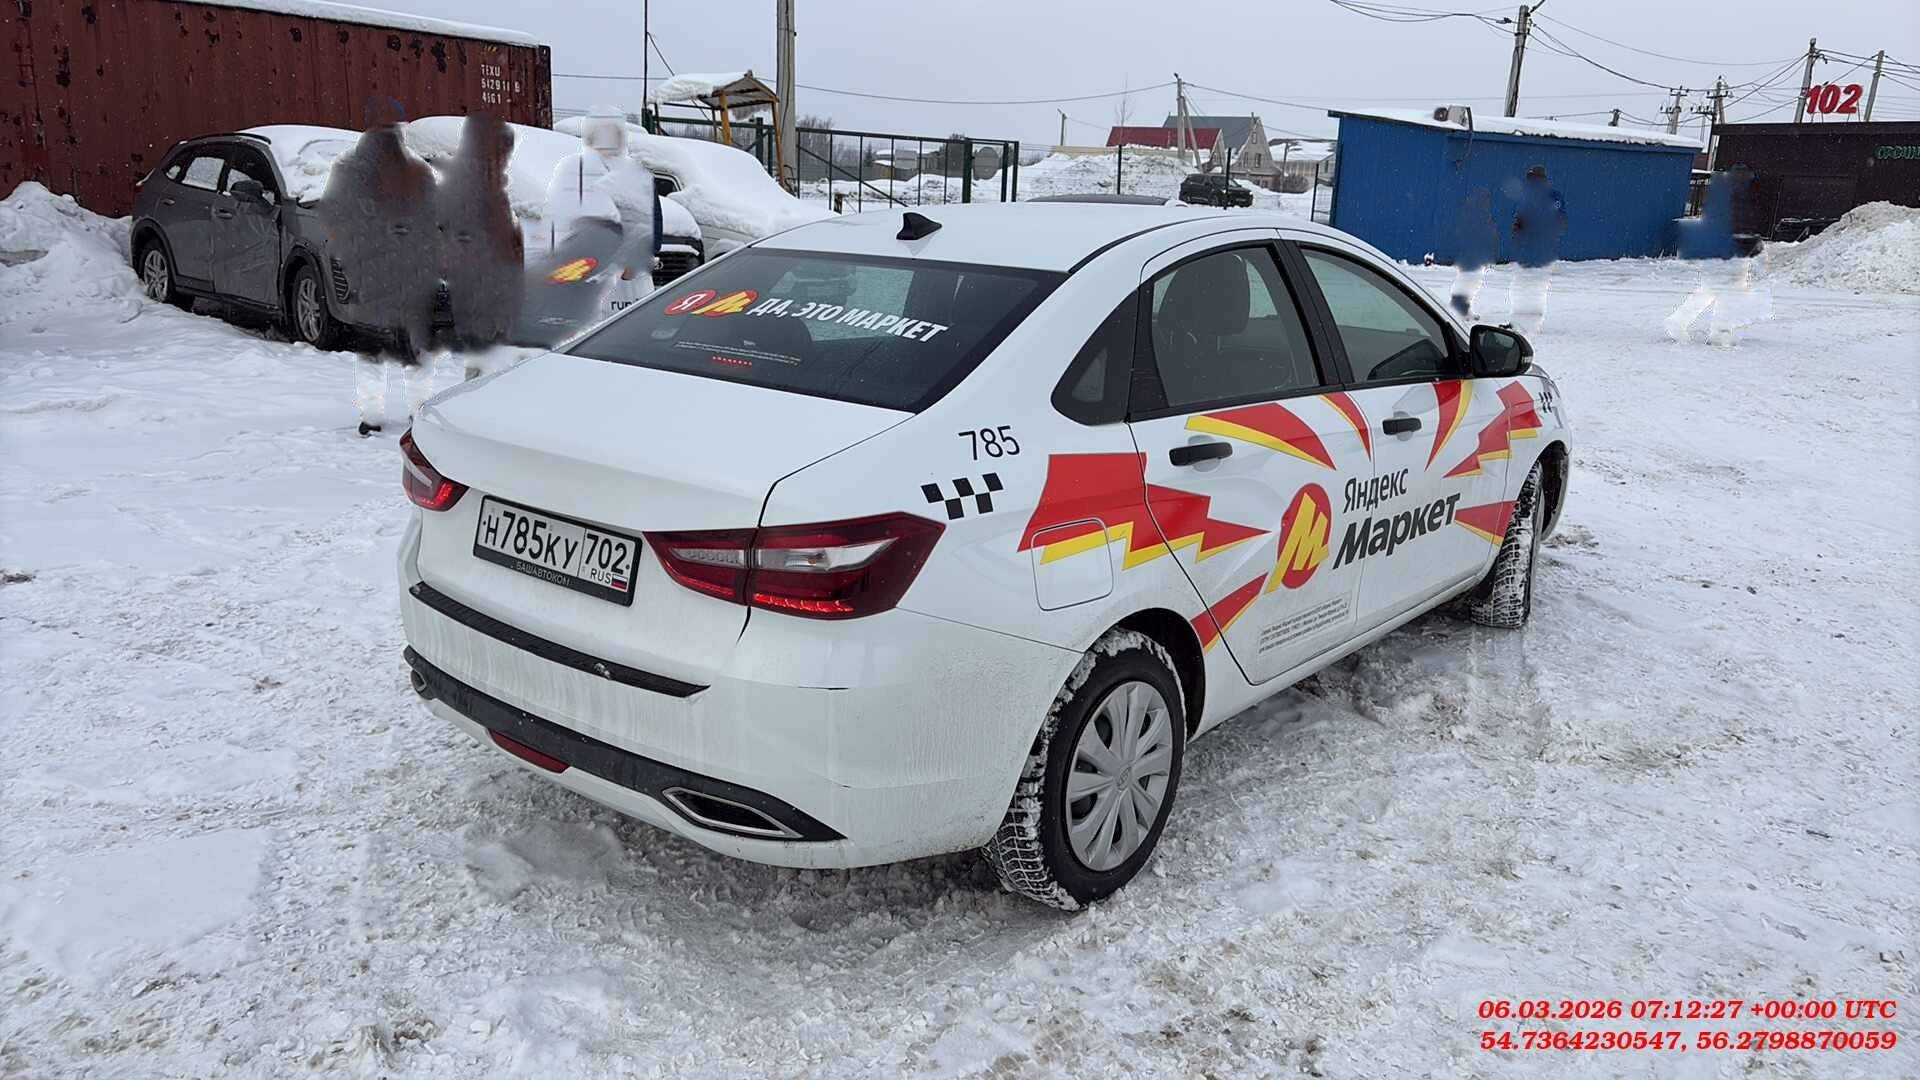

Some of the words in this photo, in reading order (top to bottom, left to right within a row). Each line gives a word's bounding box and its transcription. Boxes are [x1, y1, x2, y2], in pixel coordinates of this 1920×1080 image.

[480, 64, 501, 77] TEXU
[1806, 84, 1863, 114] 102
[745, 298, 795, 318] ДА,
[791, 302, 844, 321] ЭТО
[835, 308, 949, 343] МАРКЕТ
[958, 425, 1020, 460] 785
[1342, 468, 1409, 514] Яндекс
[1332, 493, 1461, 570] Маркет
[585, 533, 628, 575] 702
[590, 567, 612, 585] RUS
